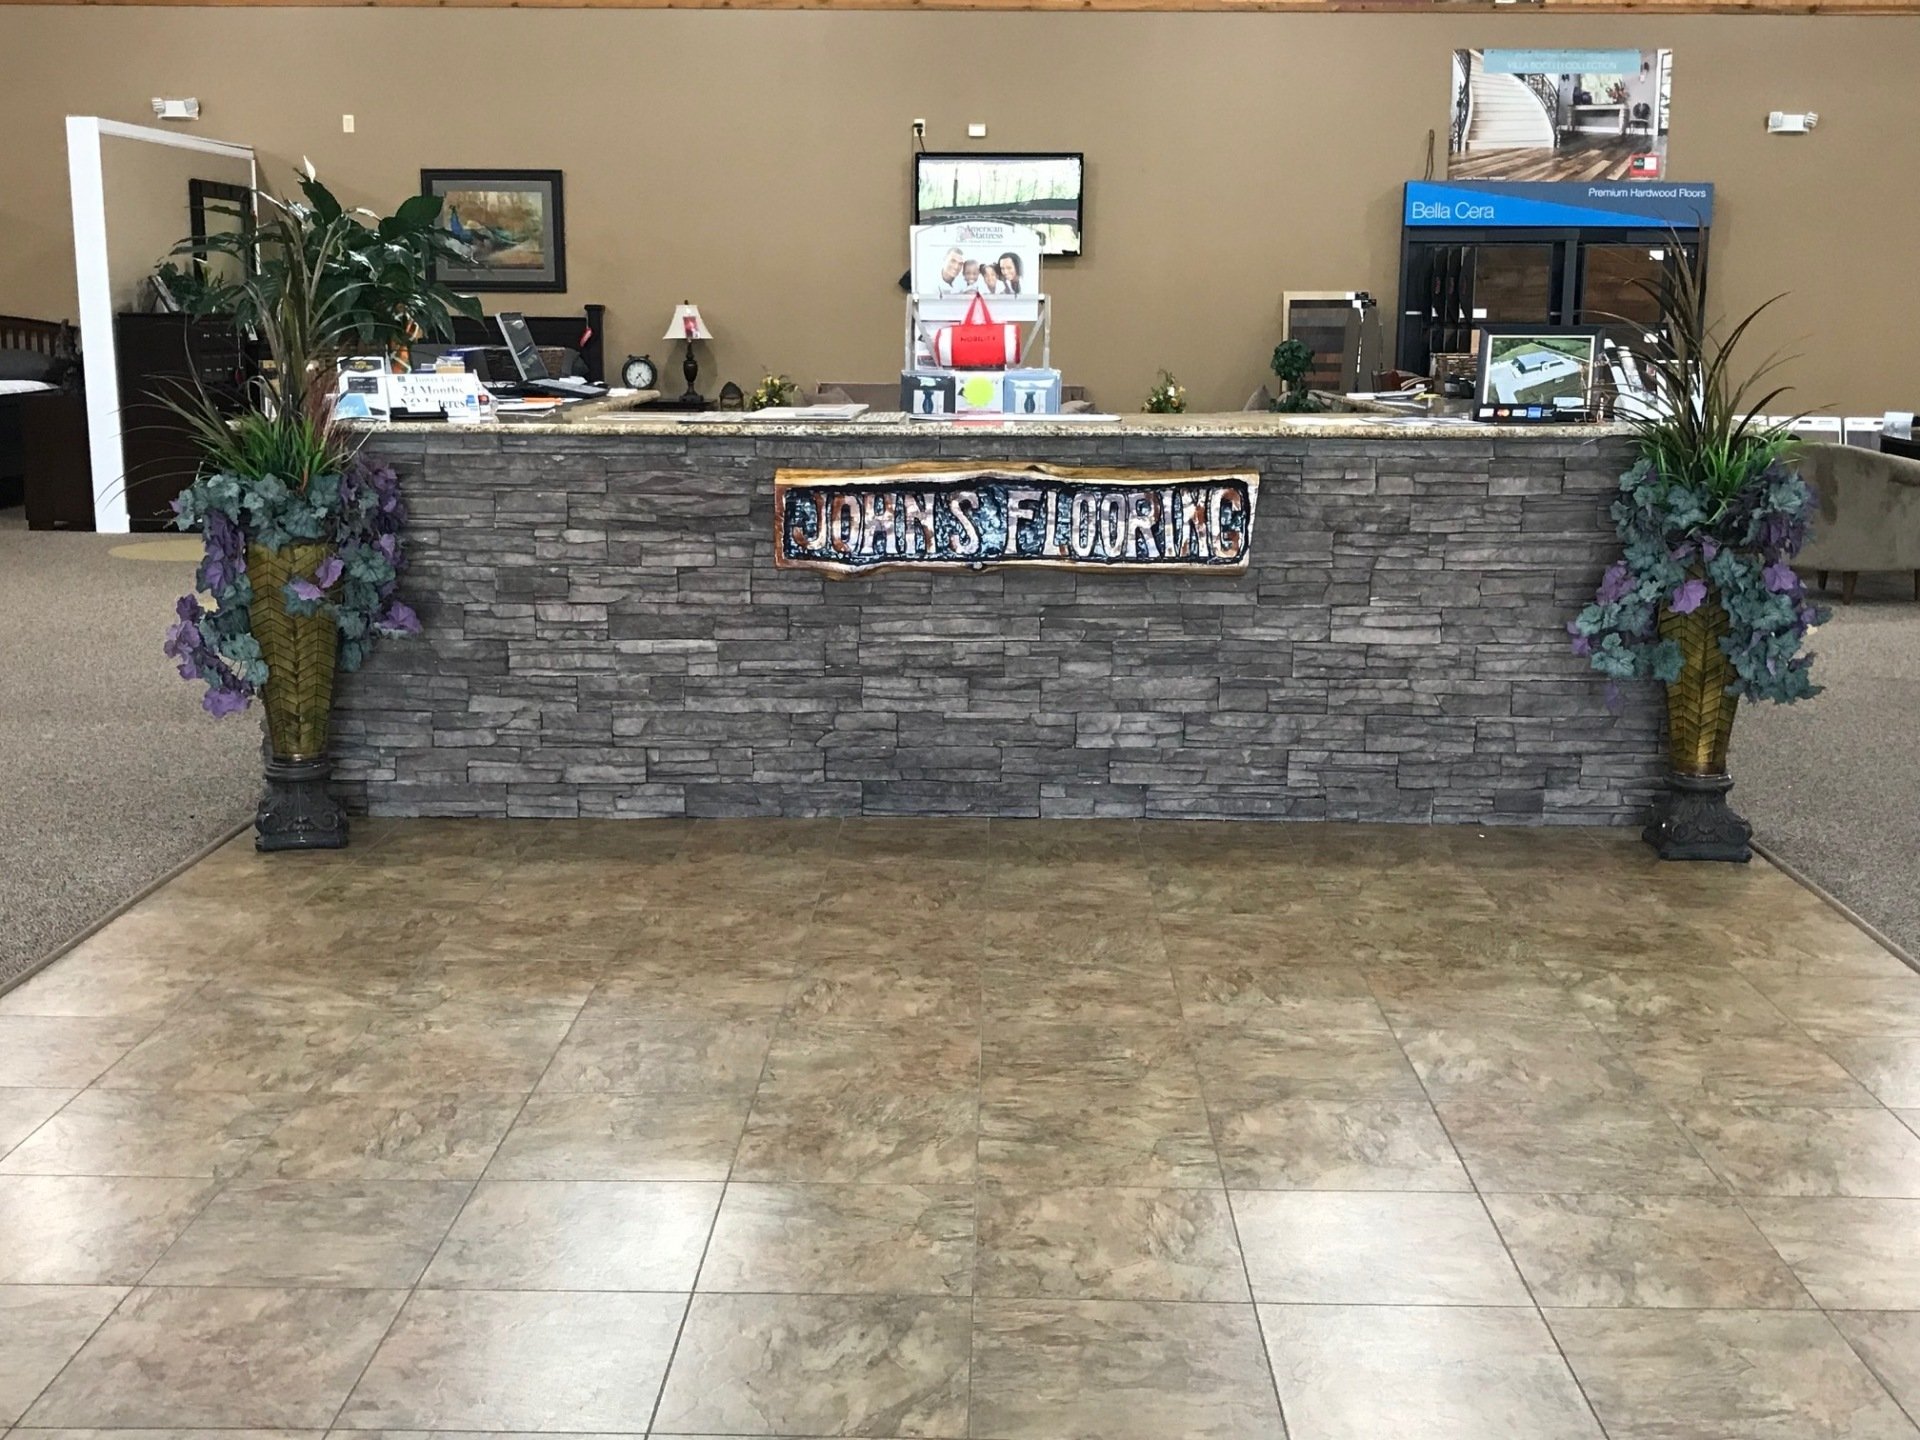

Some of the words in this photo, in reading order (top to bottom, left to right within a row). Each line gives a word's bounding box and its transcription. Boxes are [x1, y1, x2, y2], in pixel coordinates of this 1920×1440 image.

[1565, 61, 1617, 70] COLLECTION
[1587, 187, 1628, 198] Premium
[1630, 187, 1677, 198] Hardwood
[1679, 187, 1706, 198] Floors
[1412, 201, 1450, 219] Bella
[1454, 201, 1494, 219] Cera
[964, 224, 1003, 233] American
[402, 385, 415, 396] 24
[420, 385, 465, 394] Months
[1003, 485, 1246, 560] FLOORING
